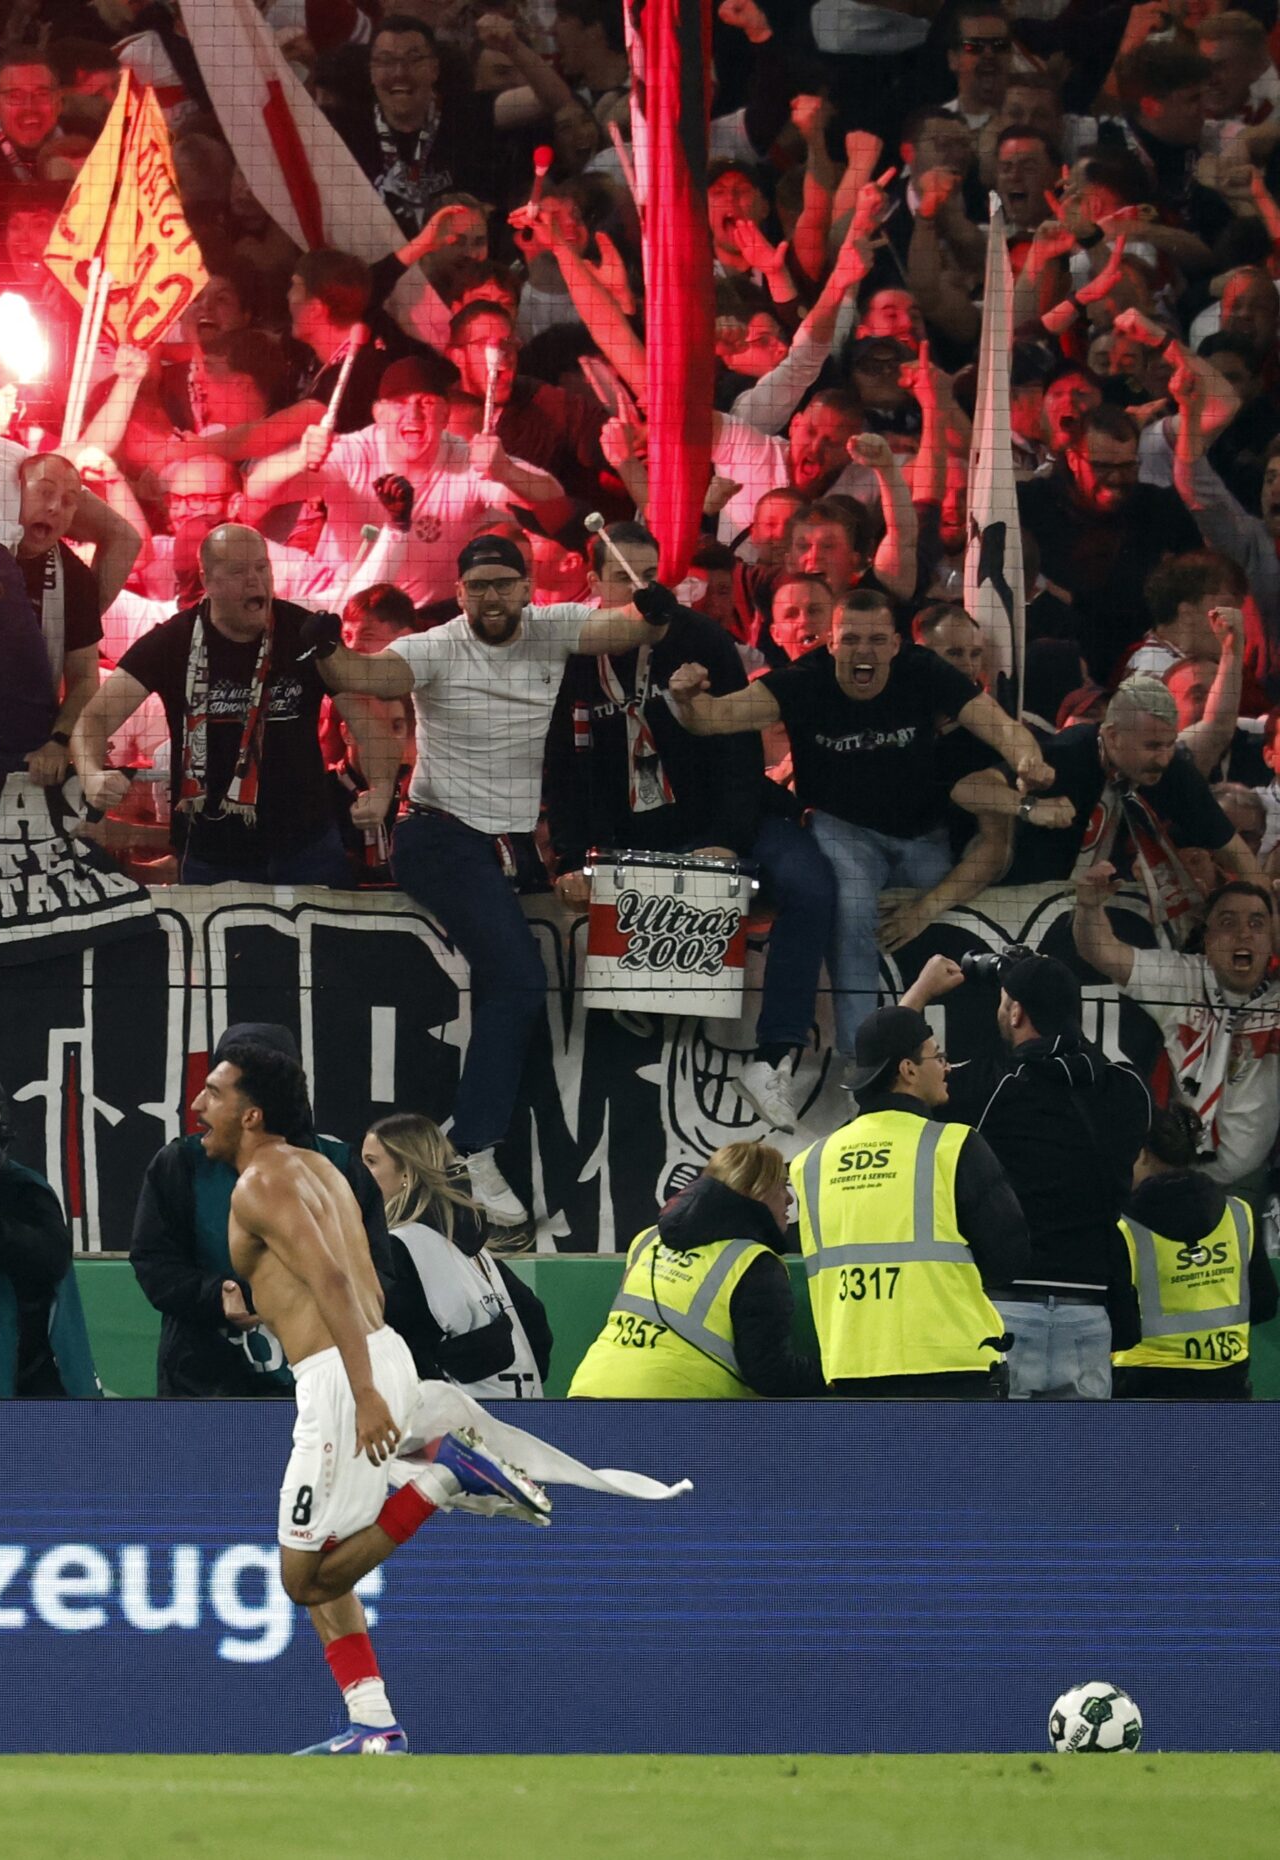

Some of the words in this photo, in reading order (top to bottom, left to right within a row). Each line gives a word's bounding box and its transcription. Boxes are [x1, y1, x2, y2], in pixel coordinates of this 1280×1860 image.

[618, 890, 741, 938] Ultras
[618, 935, 727, 976] 2002
[837, 1149, 891, 1172] SDS
[847, 1142, 878, 1150] AUFTRAG
[830, 1173, 861, 1185] SECURITY
[862, 1172, 867, 1181] &
[868, 1172, 897, 1181] SERVICE
[1176, 1242, 1228, 1271] SDS
[839, 1267, 900, 1301] 3317
[613, 1315, 668, 1349] 1357
[1185, 1330, 1242, 1361] 0185
[292, 1484, 313, 1526] 8
[290, 1529, 313, 1540] JAKO
